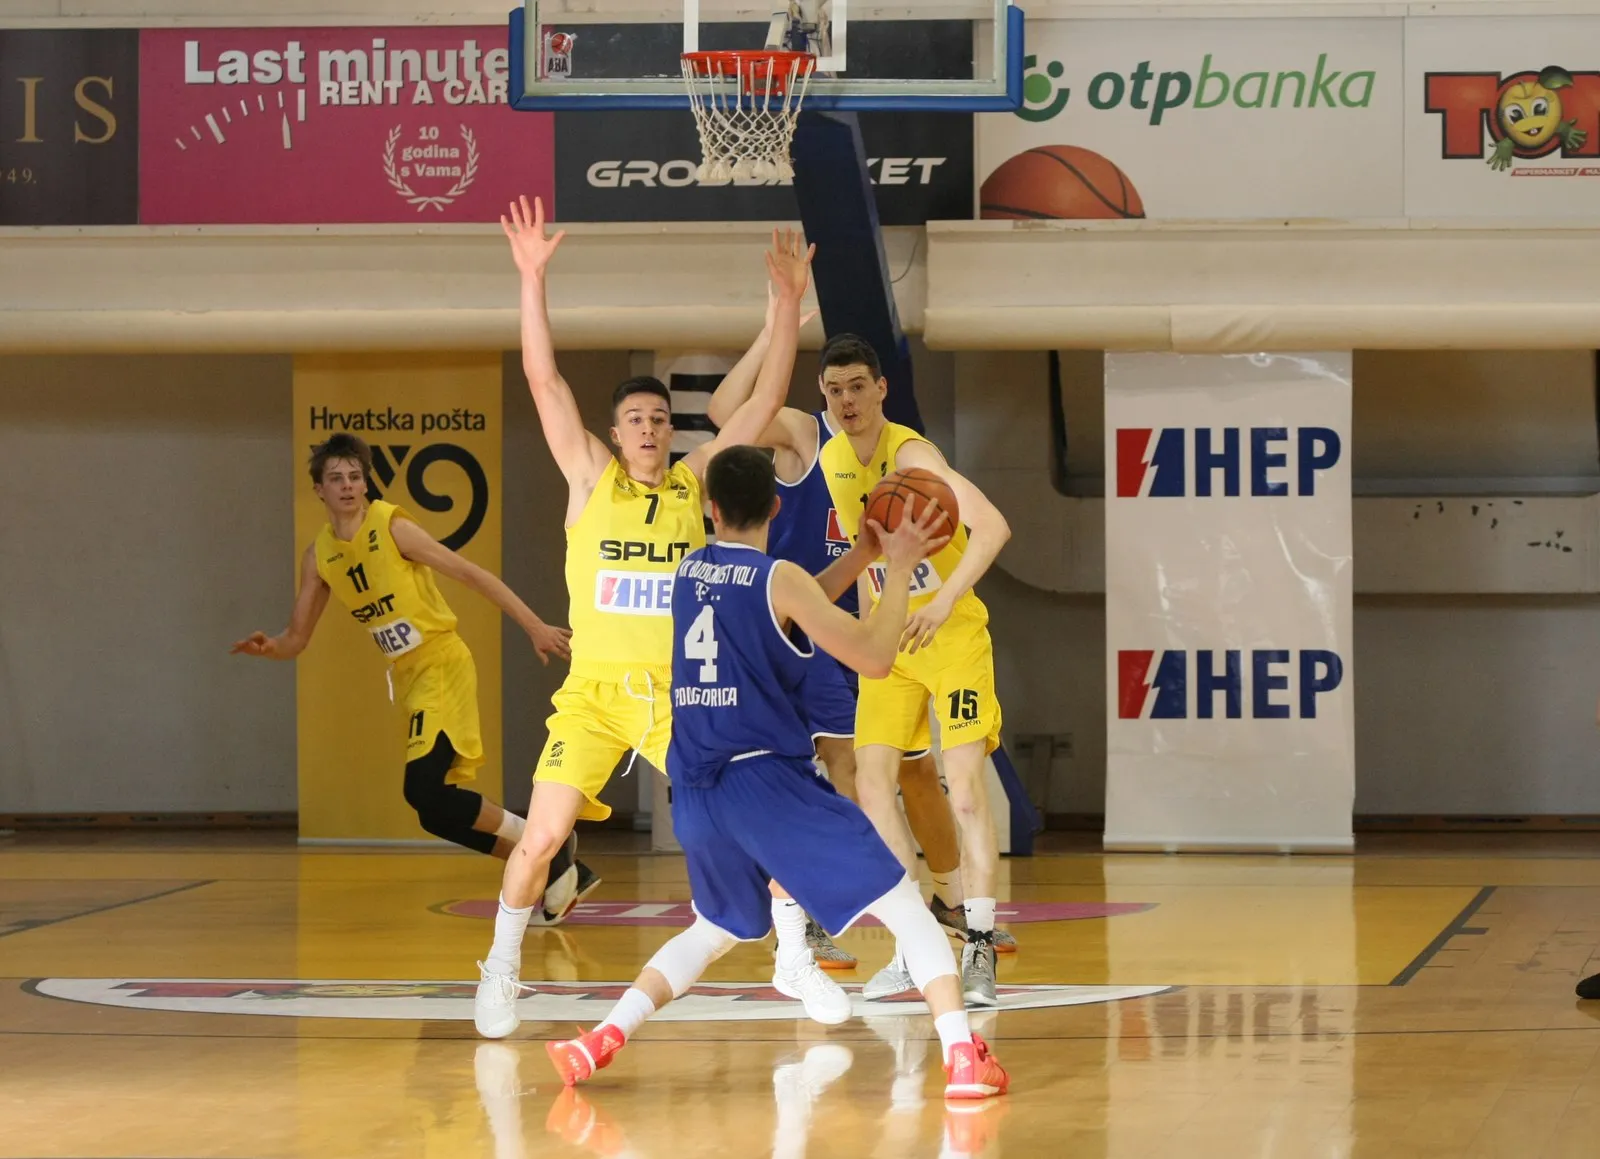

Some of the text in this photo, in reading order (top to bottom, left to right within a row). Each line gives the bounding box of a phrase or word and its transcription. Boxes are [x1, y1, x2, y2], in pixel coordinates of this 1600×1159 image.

[185, 38, 509, 84] Last minute
[320, 80, 508, 105] RENT A CAR
[1088, 53, 1376, 125] otpbanka
[419, 126, 439, 140] 10
[402, 145, 460, 161] godina
[0, 168, 37, 184] 49.
[401, 163, 461, 177] s Vama
[310, 406, 486, 435] Hrvatska pošta
[1195, 427, 1341, 497] HEP
[645, 494, 659, 524] 7
[600, 540, 690, 563] SPLIT
[825, 543, 850, 557] Tea
[346, 563, 370, 594] 11
[633, 578, 671, 609] HE
[351, 594, 395, 623] SPLIT
[684, 605, 718, 683] 4
[1197, 650, 1344, 719] HEP
[948, 689, 978, 720] 15
